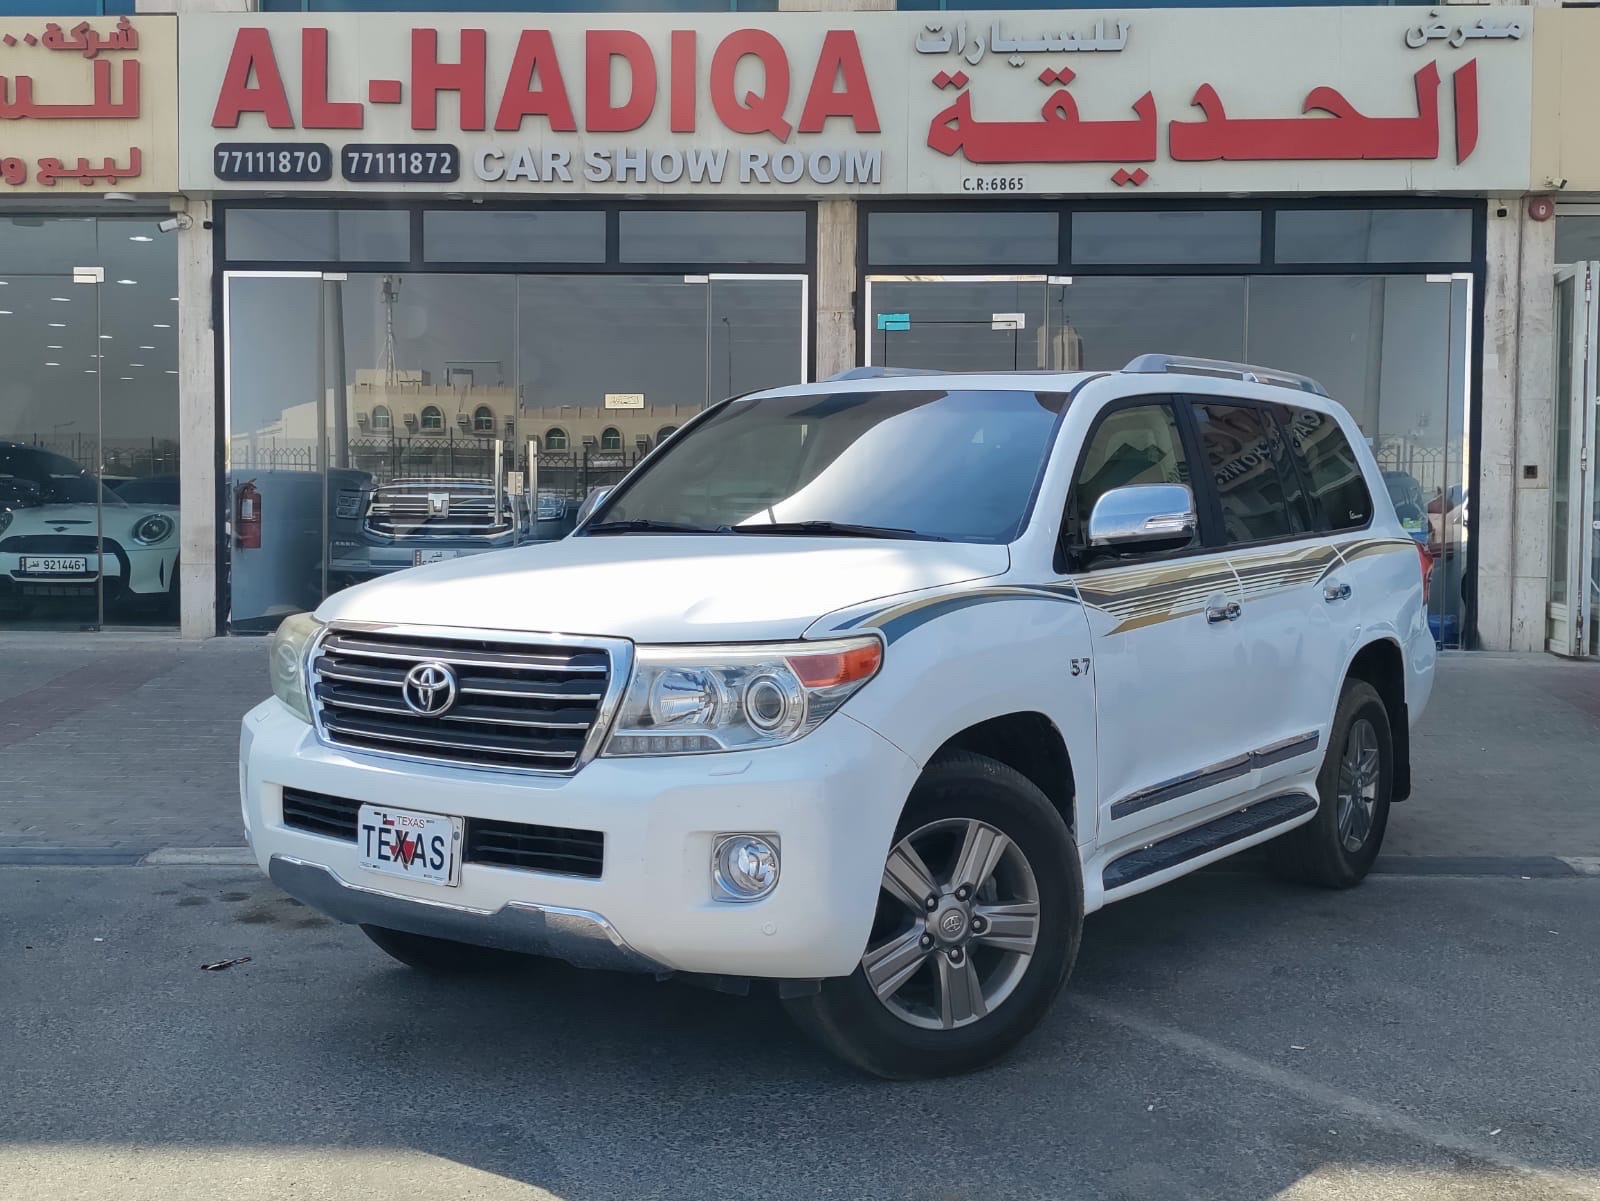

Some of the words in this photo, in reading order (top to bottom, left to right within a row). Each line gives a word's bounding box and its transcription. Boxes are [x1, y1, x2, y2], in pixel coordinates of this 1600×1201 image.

[916, 18, 1131, 67] للسيارات
[1405, 10, 1521, 49] معرض
[211, 27, 882, 144] AL-HADIQA
[927, 57, 1479, 187] الحديقة
[217, 151, 322, 174] 77111870
[347, 152, 452, 175] 77111872
[473, 146, 573, 183] CAR
[583, 147, 729, 184] SHOW
[739, 148, 882, 184] ROOM
[963, 177, 1024, 191] C.R:6865
[43, 559, 81, 570] 921446
[396, 815, 425, 829] TEXAS
[362, 824, 445, 871] TEXAS
